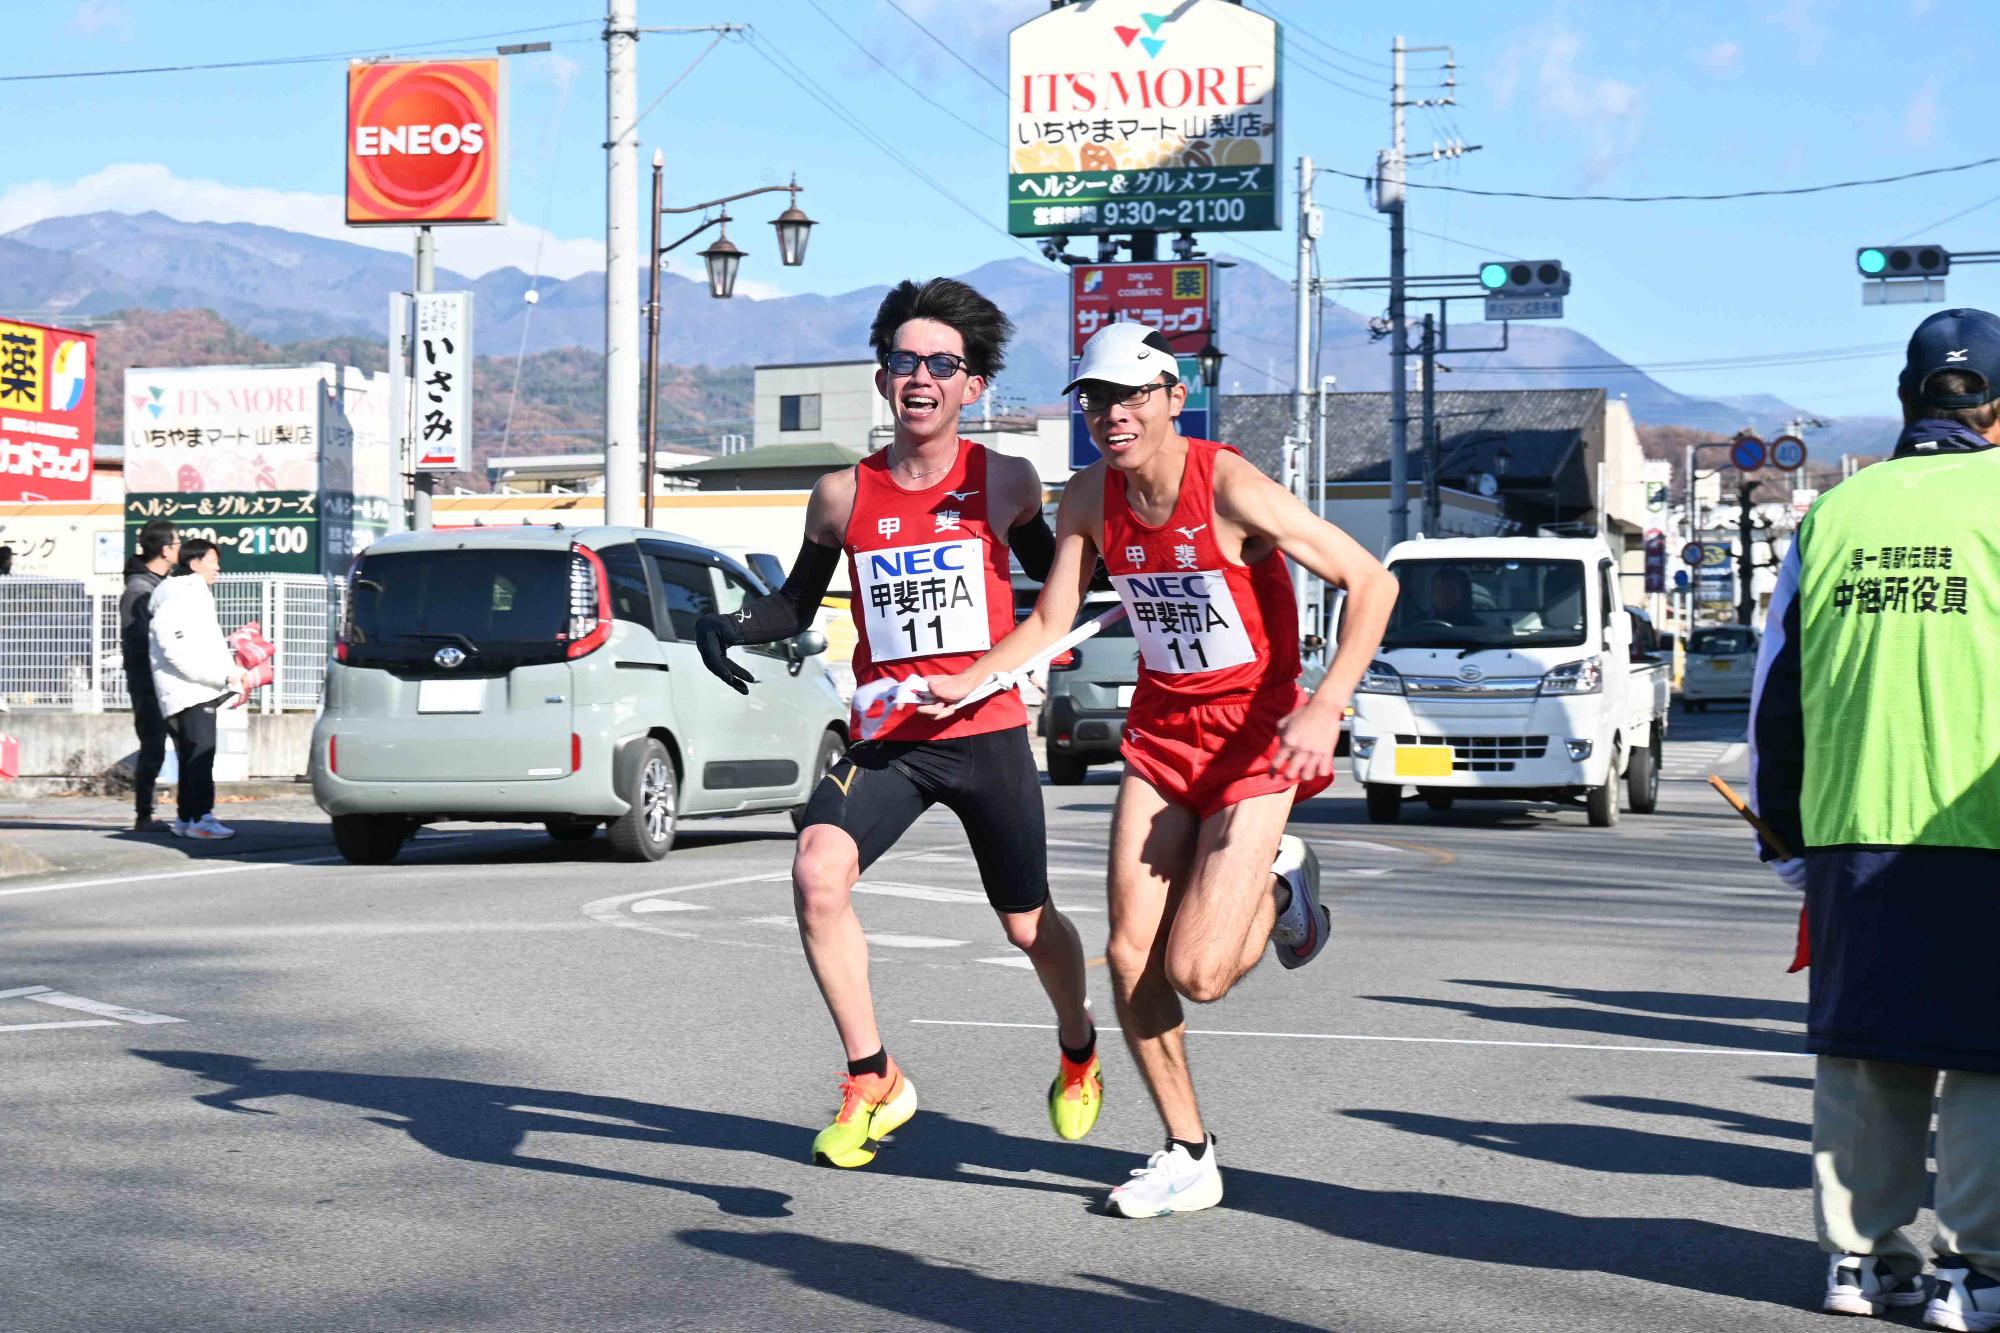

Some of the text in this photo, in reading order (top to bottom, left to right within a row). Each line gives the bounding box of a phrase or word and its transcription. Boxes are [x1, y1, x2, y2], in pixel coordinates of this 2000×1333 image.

[1103, 65, 1263, 110] MORE
[355, 123, 484, 156] ENEOS
[1018, 113, 1263, 145] いちやまマート 山梨店
[1, 332, 37, 403] 薬
[226, 386, 313, 414] MORE
[423, 337, 455, 441] いさみ
[132, 424, 313, 448] いちやまマート 山梨店
[128, 495, 317, 518] ヘルシー&グルメフーズ
[870, 544, 965, 580] NEC
[870, 575, 974, 618] 甲斐市A
[1127, 575, 1211, 599] NEC
[1834, 577, 1968, 617] 中継所役員
[901, 615, 944, 653] 11
[1133, 601, 1230, 635] 甲斐市A
[1166, 637, 1210, 670] 11
